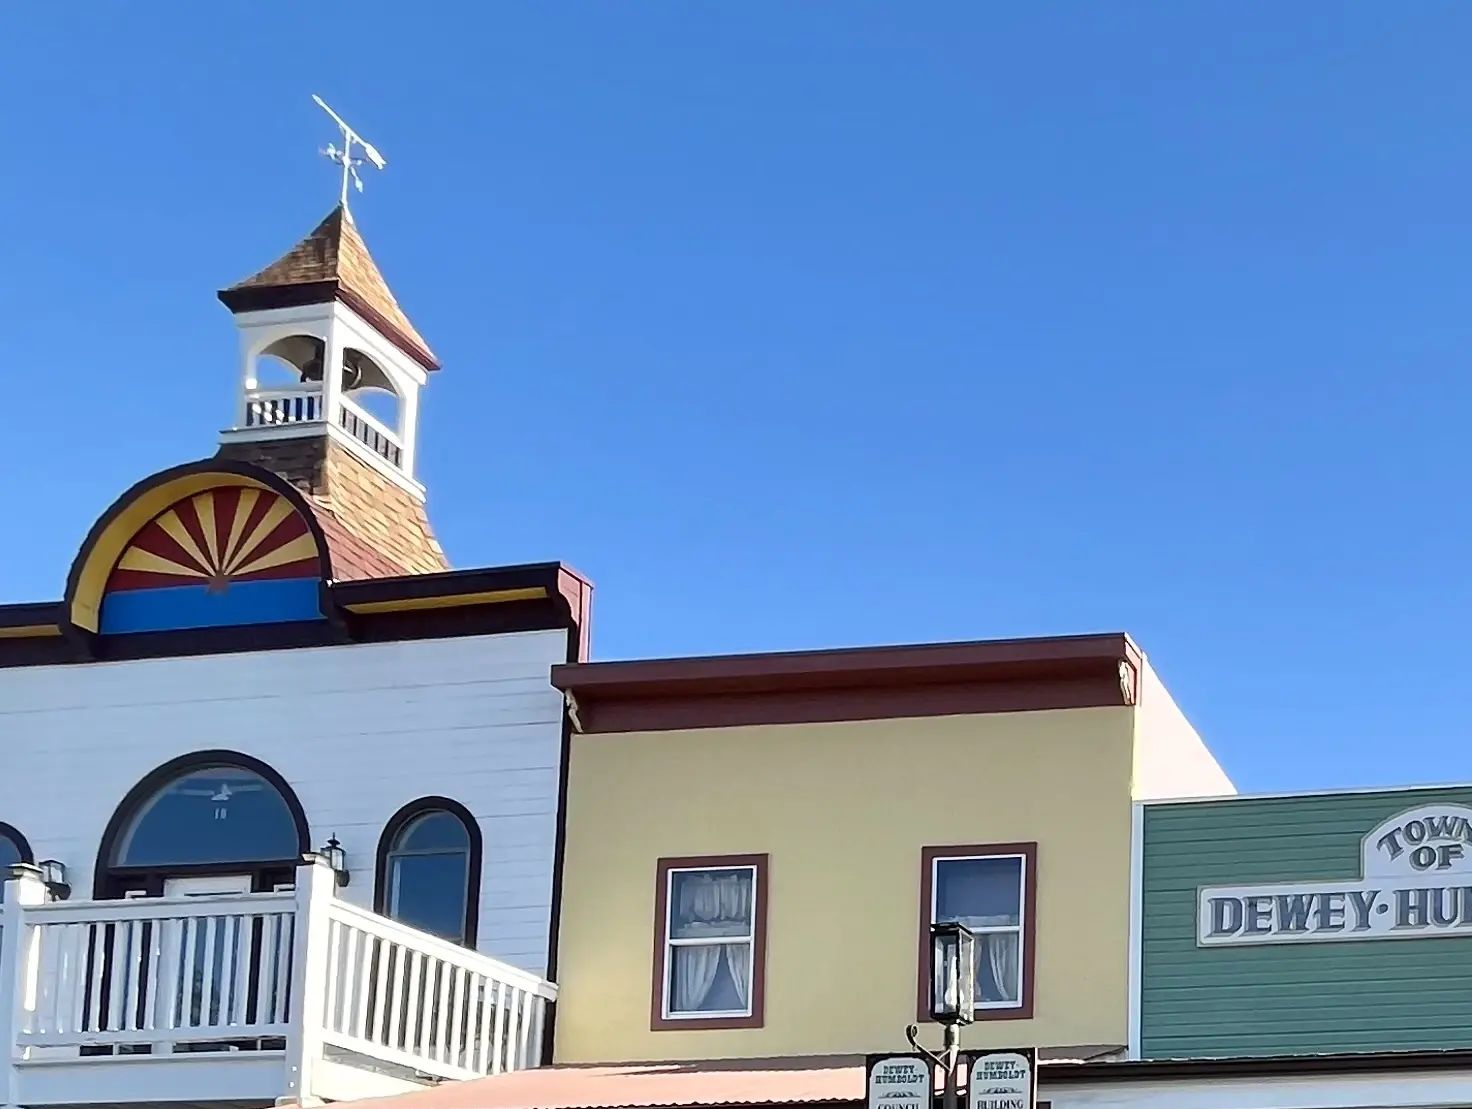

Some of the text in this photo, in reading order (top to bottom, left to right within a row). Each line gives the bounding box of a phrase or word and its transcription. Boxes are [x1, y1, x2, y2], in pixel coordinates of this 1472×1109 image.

[1408, 844, 1464, 870] OF
[875, 1074, 925, 1085] HUMBOLDT
[976, 1069, 1026, 1081] HUMBOLDT
